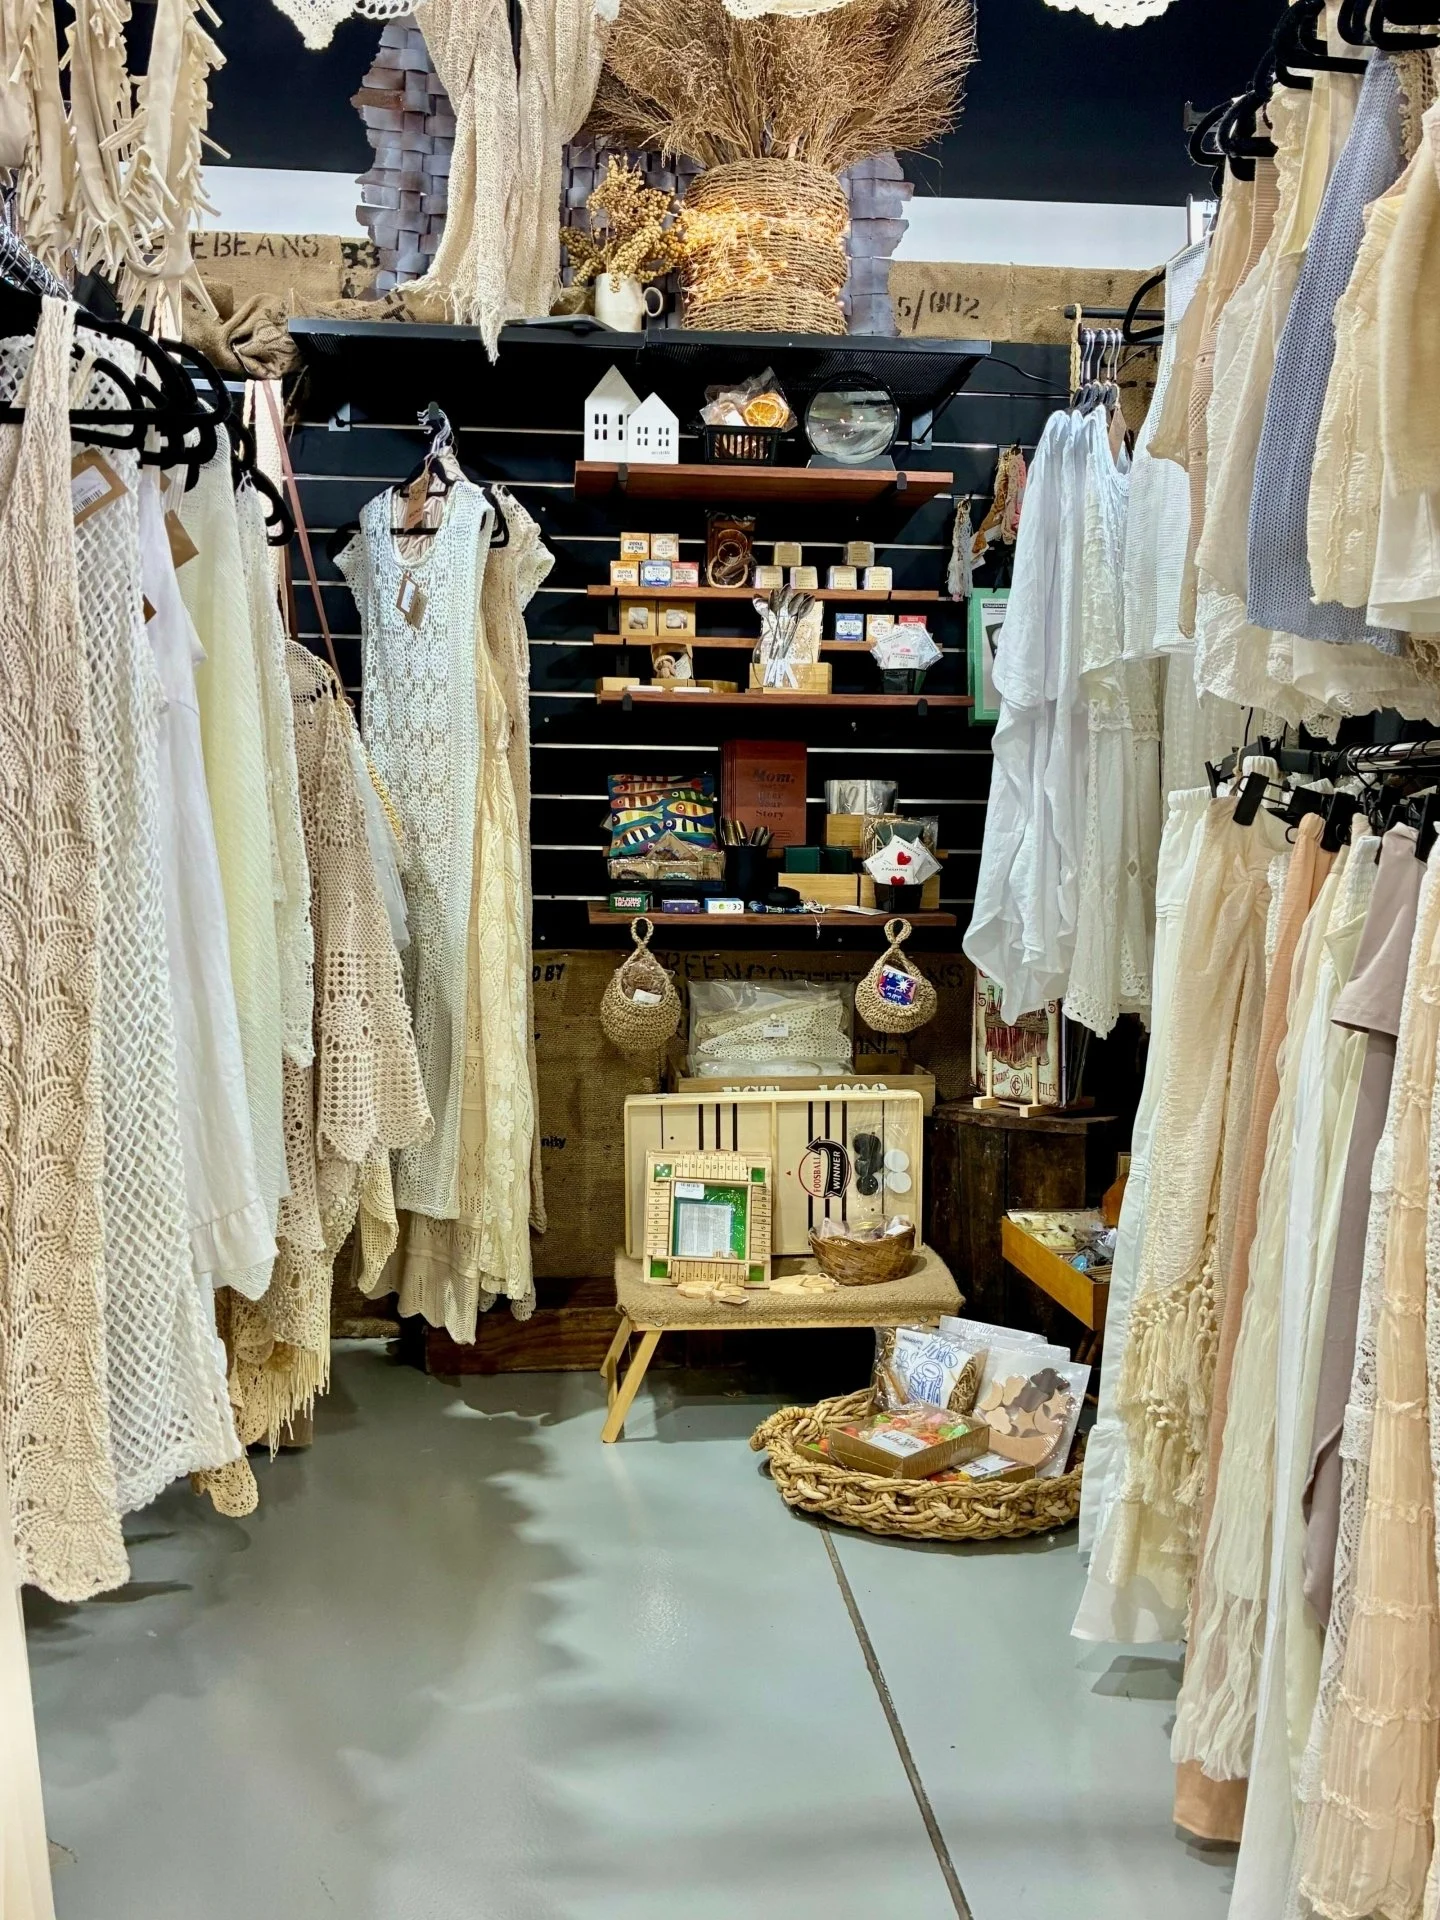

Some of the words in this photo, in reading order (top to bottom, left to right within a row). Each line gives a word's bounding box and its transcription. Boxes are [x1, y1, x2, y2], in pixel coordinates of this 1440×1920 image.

[213, 232, 320, 258] BEANS
[755, 810, 784, 821] Story
[545, 964, 566, 982] BY
[655, 952, 742, 980] REEN
[813, 1156, 822, 1193] FOOSBALL
[832, 1150, 841, 1190] WINNER
